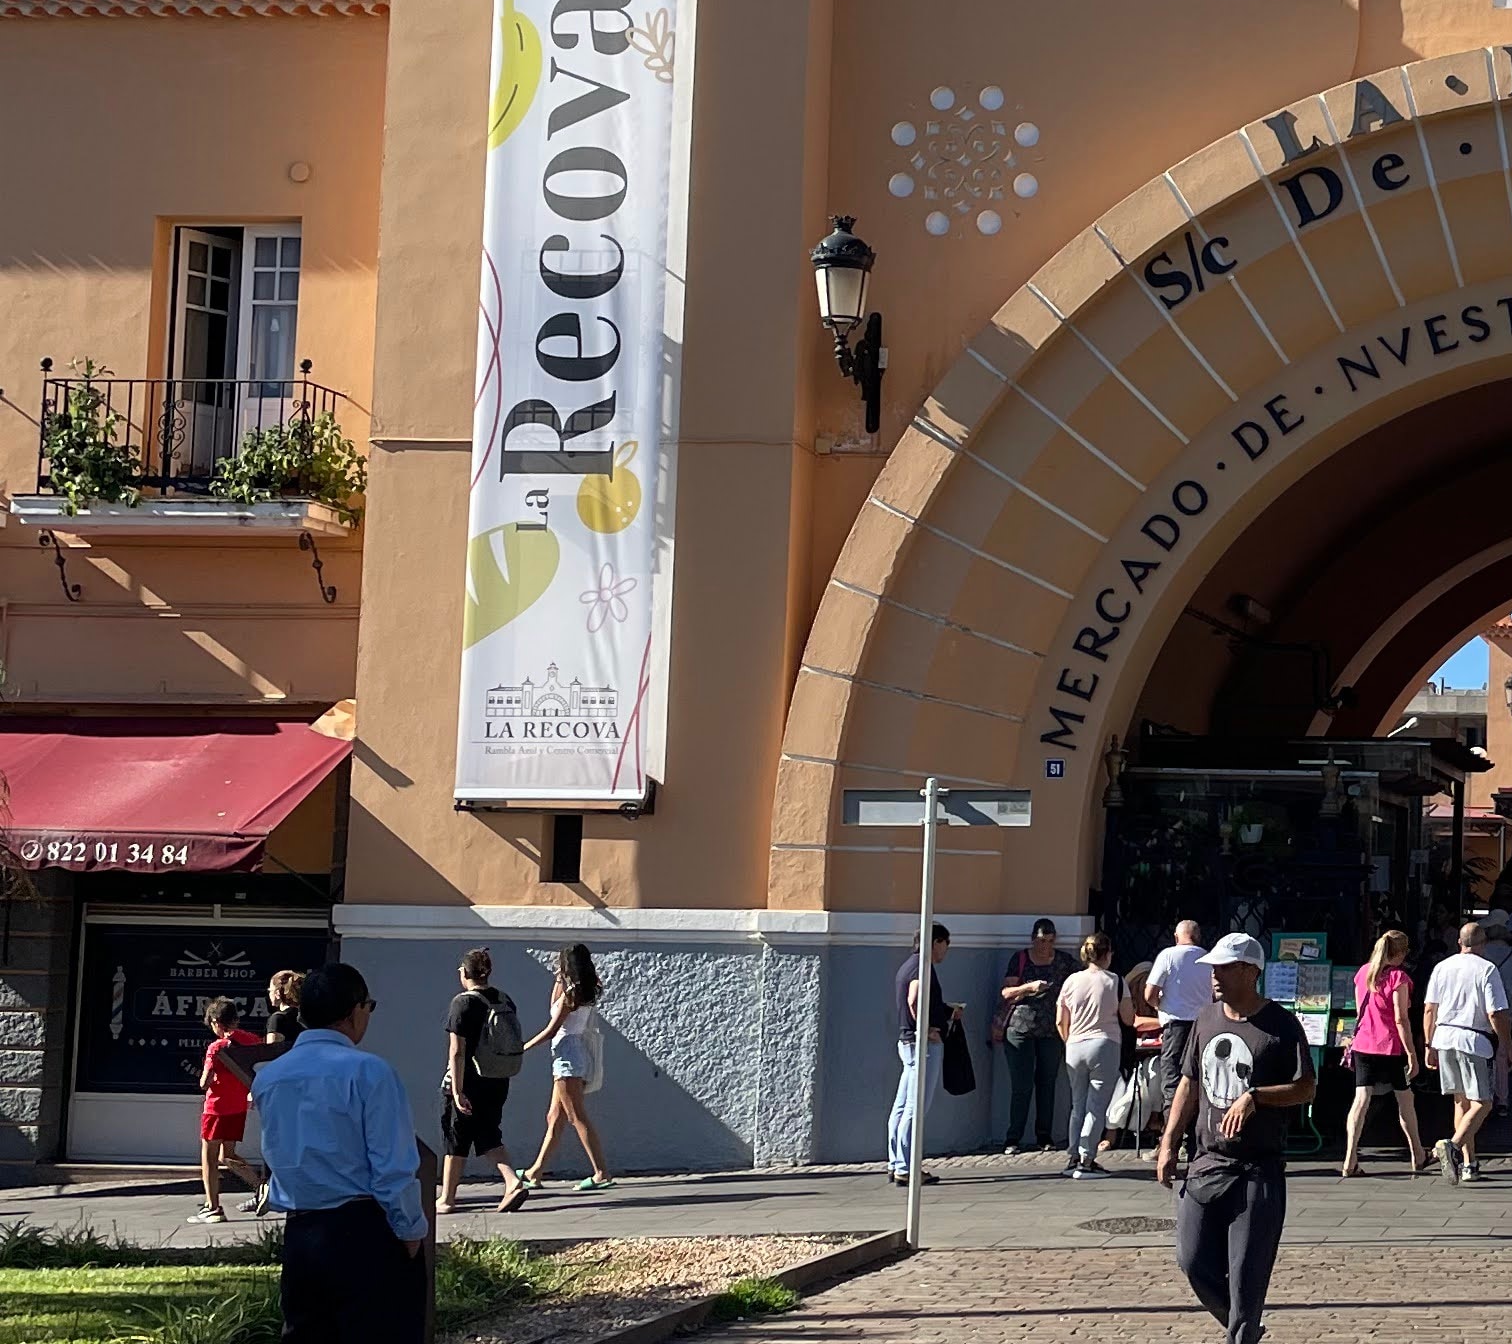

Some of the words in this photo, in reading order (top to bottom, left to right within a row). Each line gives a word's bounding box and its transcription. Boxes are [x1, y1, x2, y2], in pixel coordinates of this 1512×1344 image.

[1263, 79, 1404, 167] LA
[1278, 152, 1410, 228] De
[515, 489, 549, 532] La
[1040, 480, 1208, 750] MERCADO
[1231, 394, 1305, 461] DE
[485, 722, 514, 738] LA
[523, 722, 621, 739] RECOVA
[485, 746, 515, 755] Rambla
[1050, 763, 1060, 775] 51
[48, 842, 86, 862] 822
[95, 843, 118, 863] 01
[126, 844, 154, 864] 34
[161, 844, 188, 865] 84
[170, 968, 218, 978] BARBER
[223, 968, 256, 978] SHOP
[152, 989, 271, 1017] ÁFRCA
